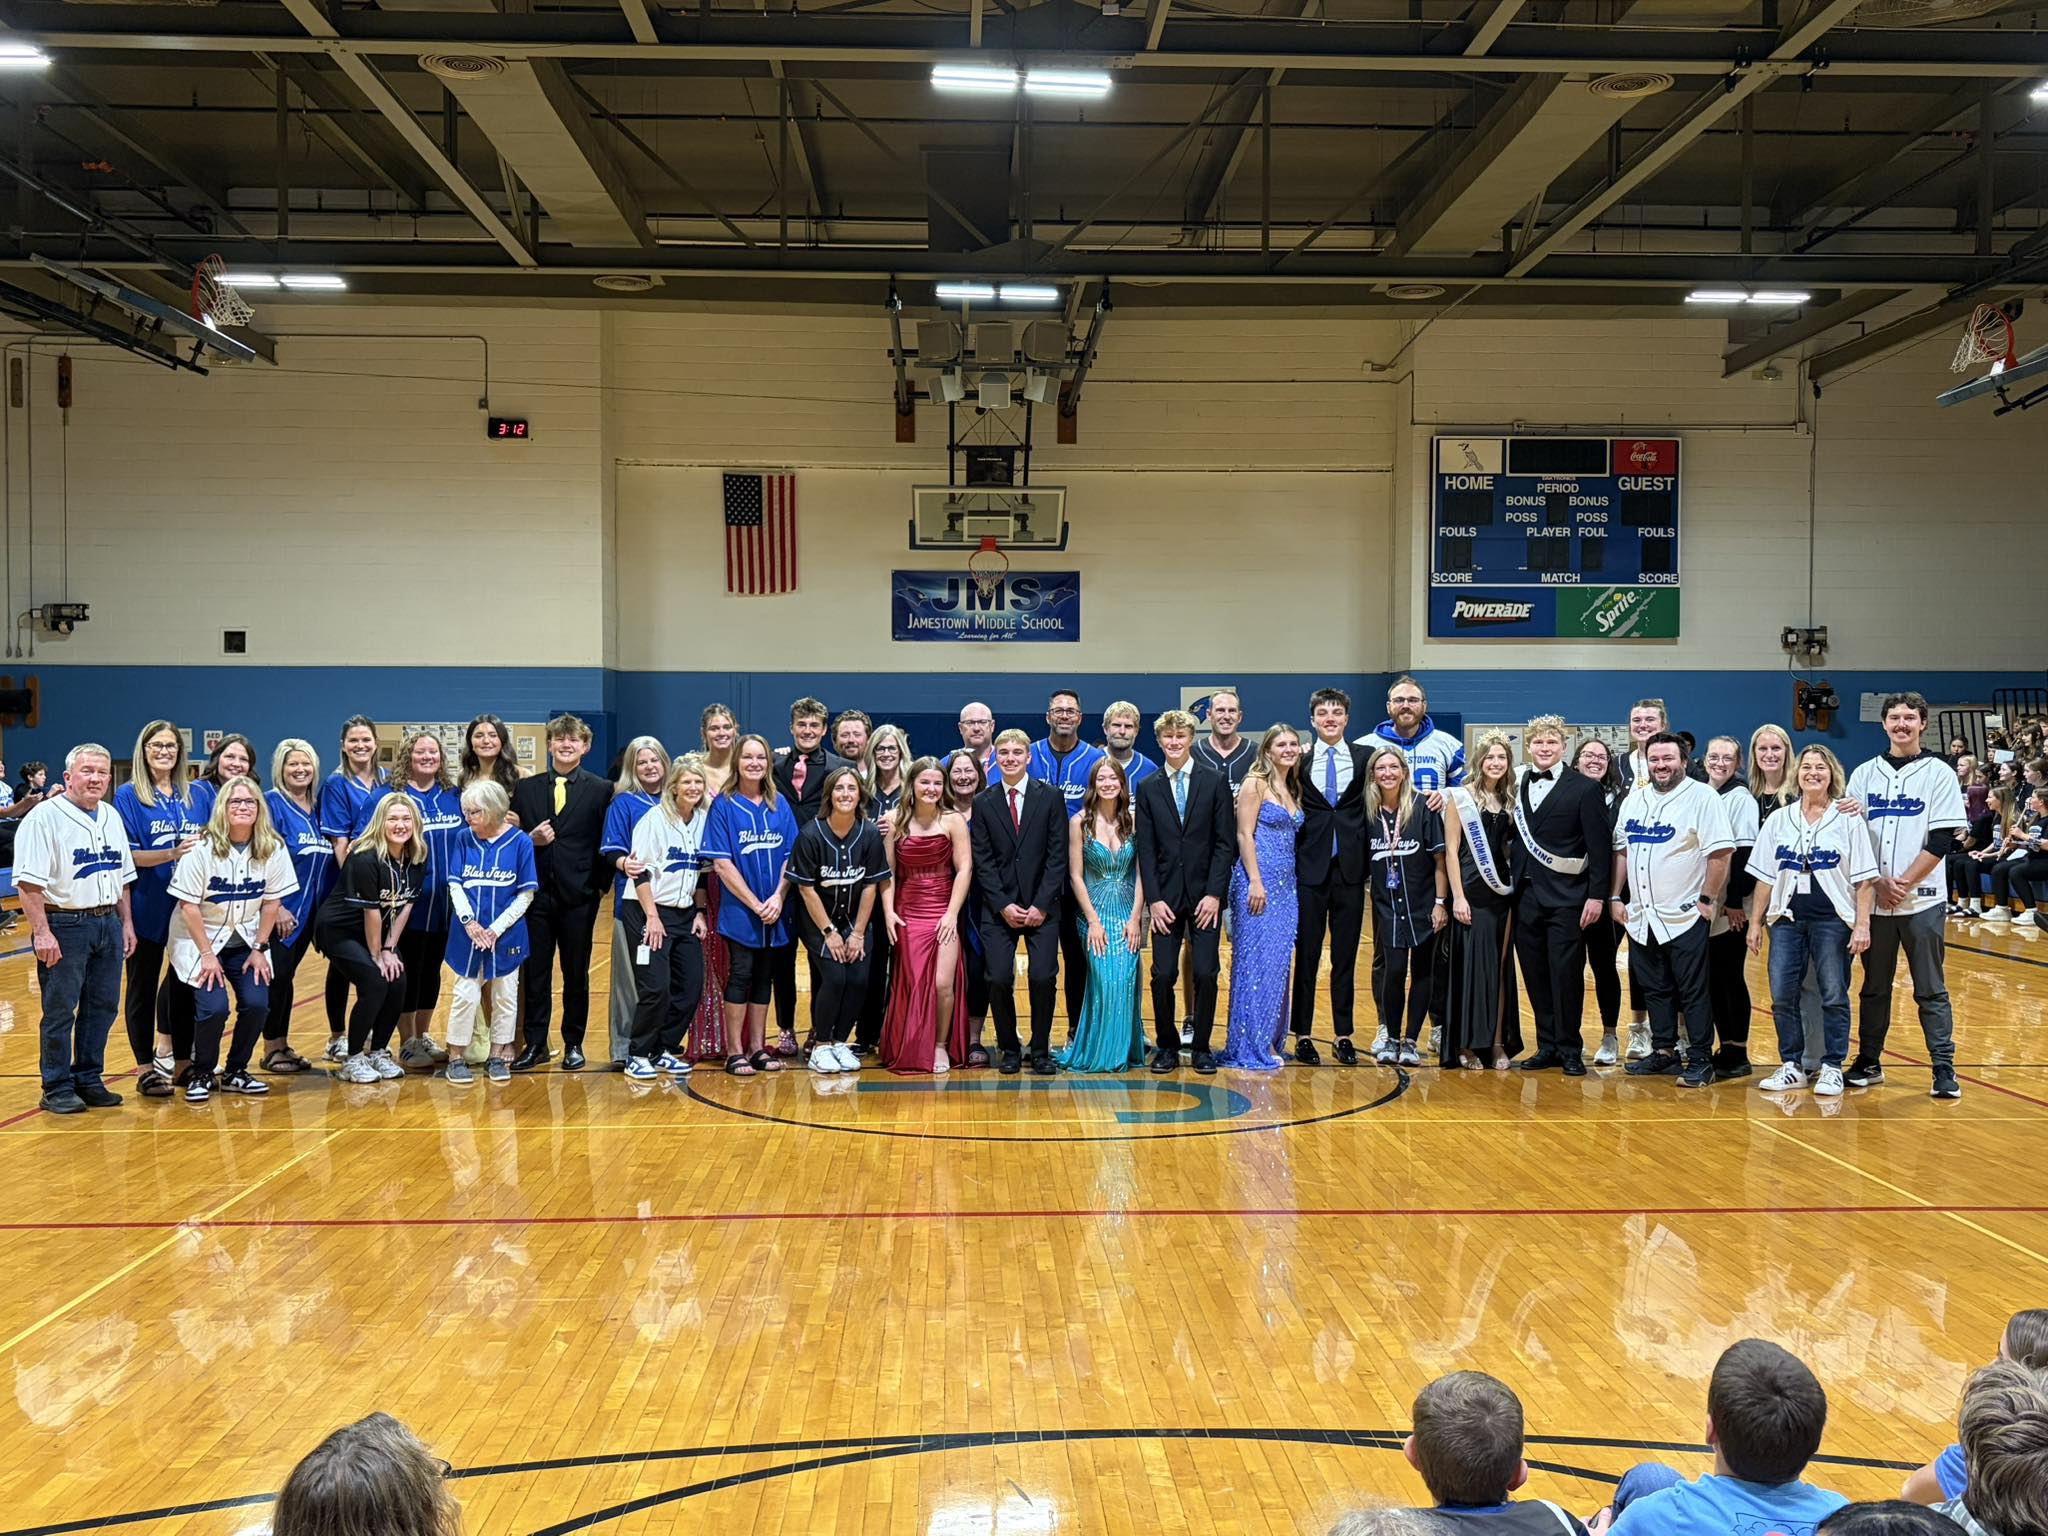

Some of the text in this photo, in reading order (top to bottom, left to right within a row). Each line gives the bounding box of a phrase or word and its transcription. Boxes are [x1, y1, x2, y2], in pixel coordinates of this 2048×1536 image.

[499, 424, 525, 435] 3:12
[1444, 477, 1494, 490] HOME
[1536, 483, 1579, 493] PERIOD
[1618, 477, 1675, 491] GUEST
[1505, 496, 1546, 506] BONUS
[1569, 496, 1609, 506] BONUS
[1505, 512, 1538, 522] POSS
[1576, 512, 1608, 522] POSS
[1439, 527, 1477, 537] FOULS
[1526, 527, 1608, 537] PLAYER FOUL
[1638, 527, 1675, 537] FOULS
[1432, 572, 1473, 583] SCORE
[1541, 573, 1581, 583] MATCH
[1638, 573, 1678, 583] SCORE
[929, 577, 1043, 613] JMS
[1595, 591, 1637, 633] Sprite
[907, 613, 1065, 630] JAMESTOWN MIDDLE SCHOOL
[989, 632, 999, 640] for
[1405, 755, 1436, 764] STOWN
[435, 812, 459, 823] Jays
[739, 829, 781, 844] Blue Jays
[1467, 821, 1502, 889] HOMECOMING QUEEN
[1532, 846, 1553, 865] KING
[462, 864, 513, 881] Blue Jays
[820, 865, 840, 878] Blue
